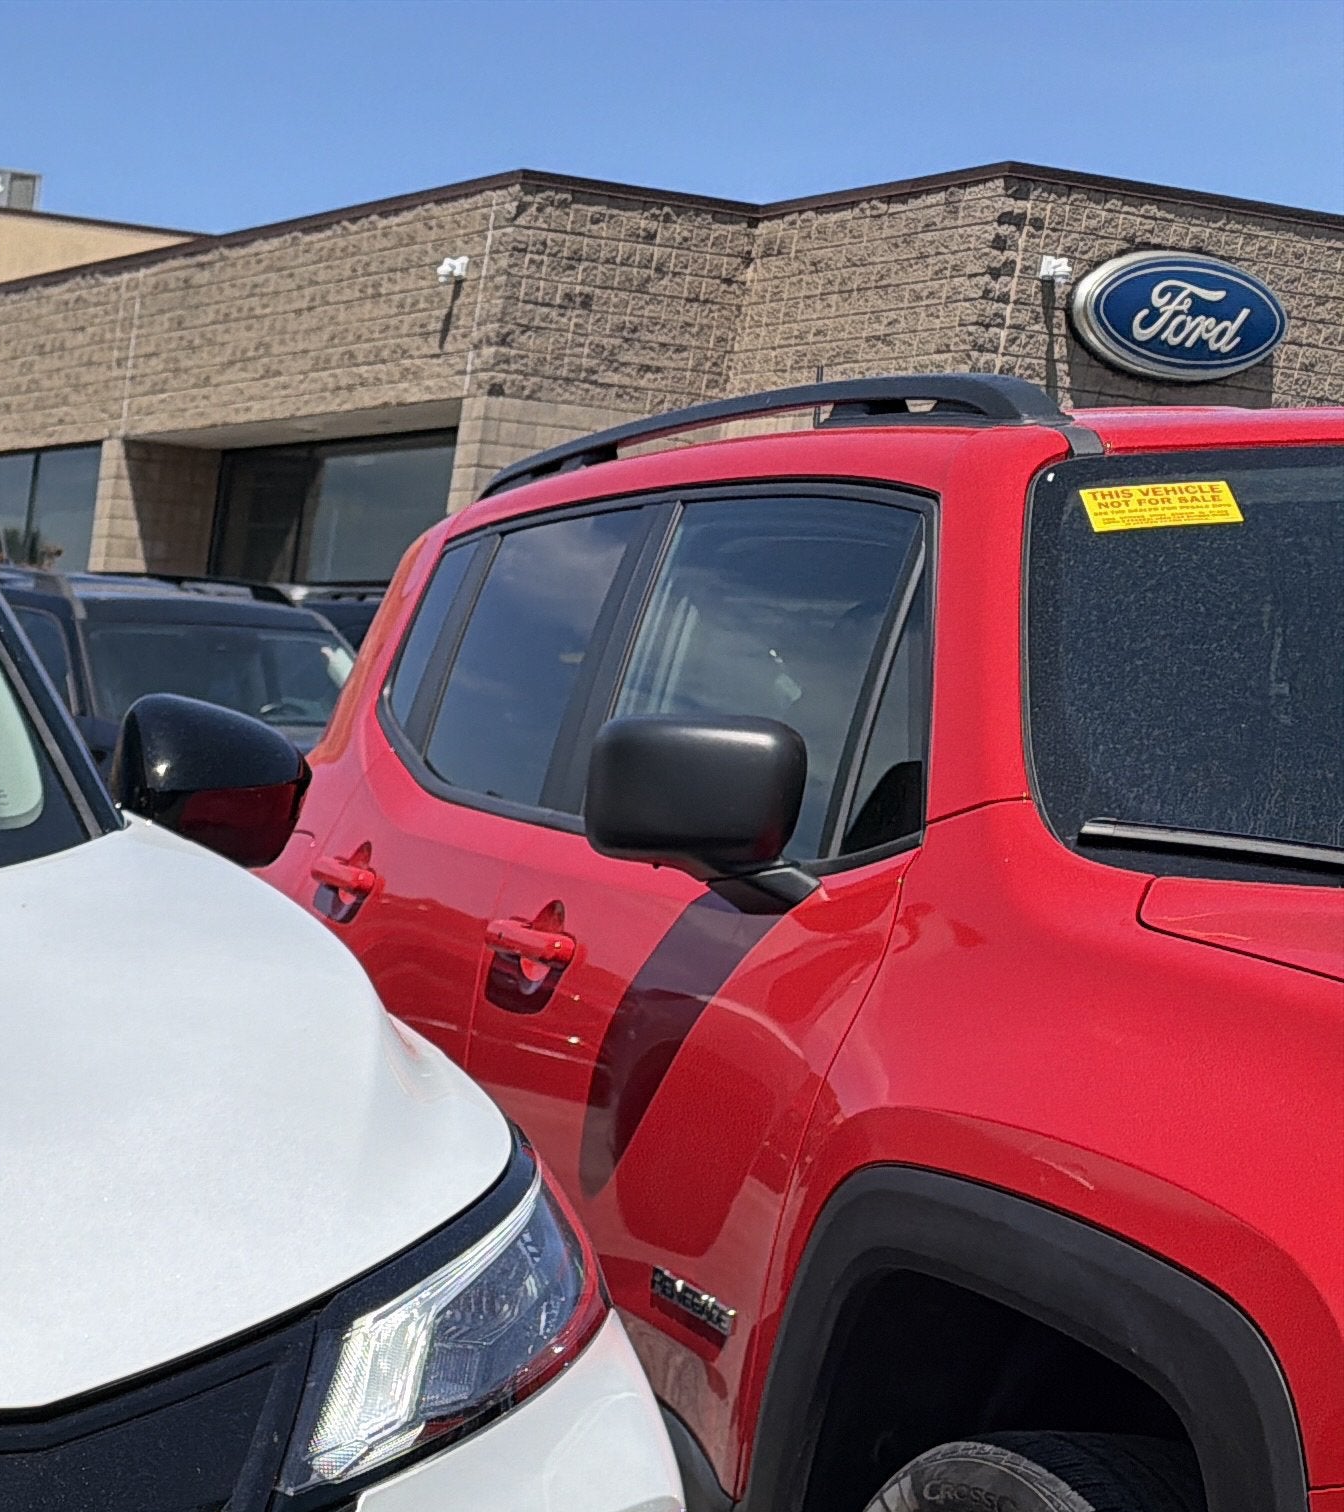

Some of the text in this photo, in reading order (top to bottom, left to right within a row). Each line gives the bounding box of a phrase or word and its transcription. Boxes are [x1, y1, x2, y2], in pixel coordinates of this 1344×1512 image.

[1132, 279, 1251, 354] Ford
[1088, 484, 1223, 501] THIS VEHICLE
[1097, 494, 1223, 509] NOT FOR SALE
